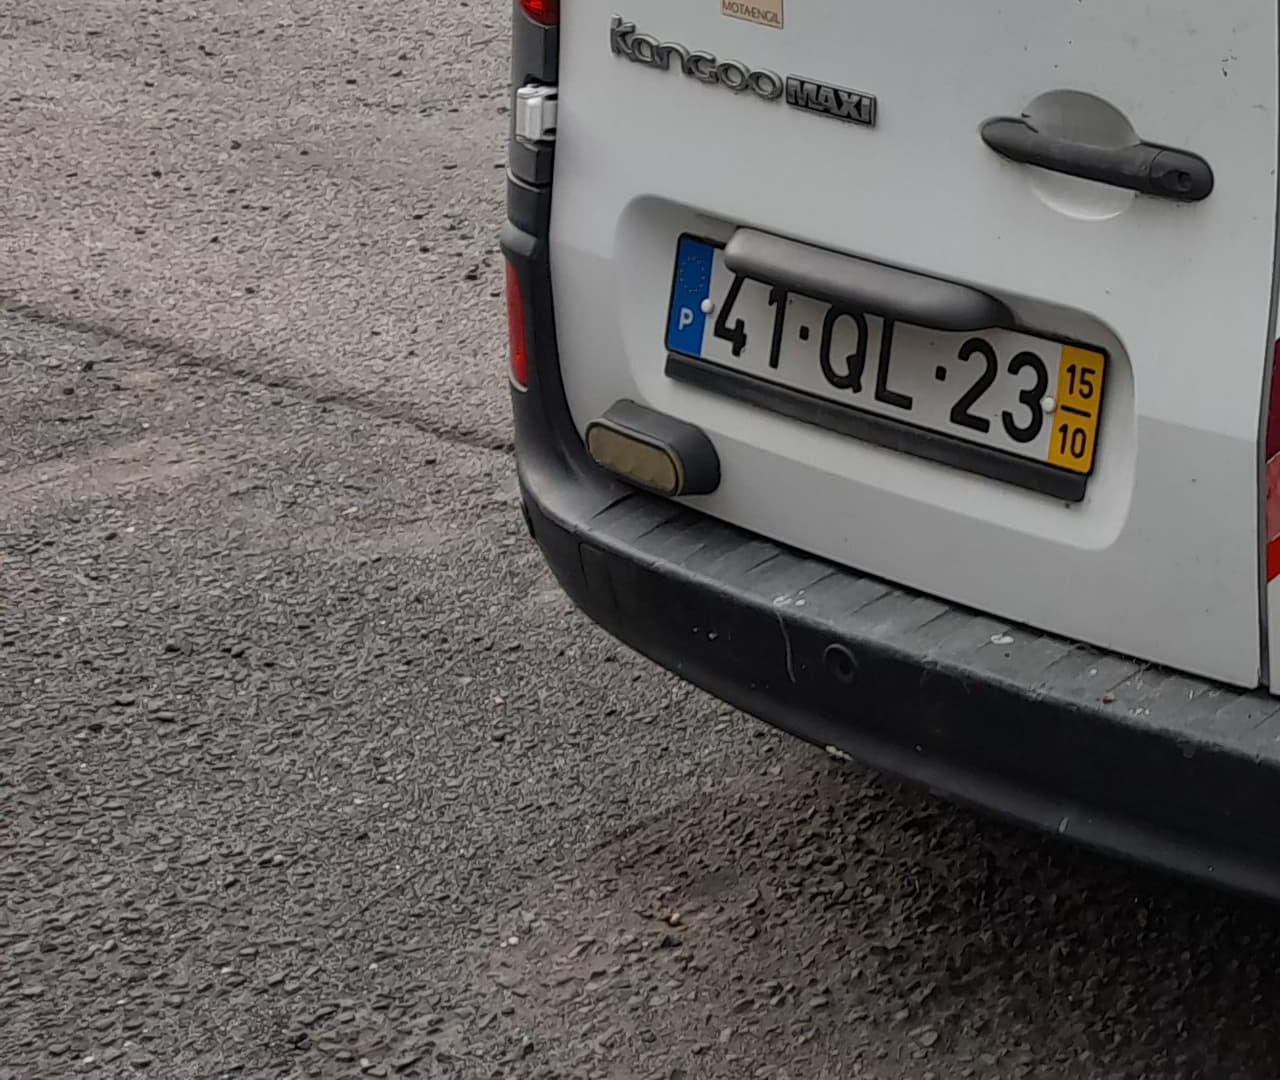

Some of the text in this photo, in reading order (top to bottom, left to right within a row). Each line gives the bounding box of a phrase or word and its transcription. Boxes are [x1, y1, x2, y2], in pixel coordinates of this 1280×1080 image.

[788, 77, 875, 125] MAXI
[678, 307, 694, 331] P
[1066, 363, 1096, 400] 15
[1058, 423, 1087, 459] 10
